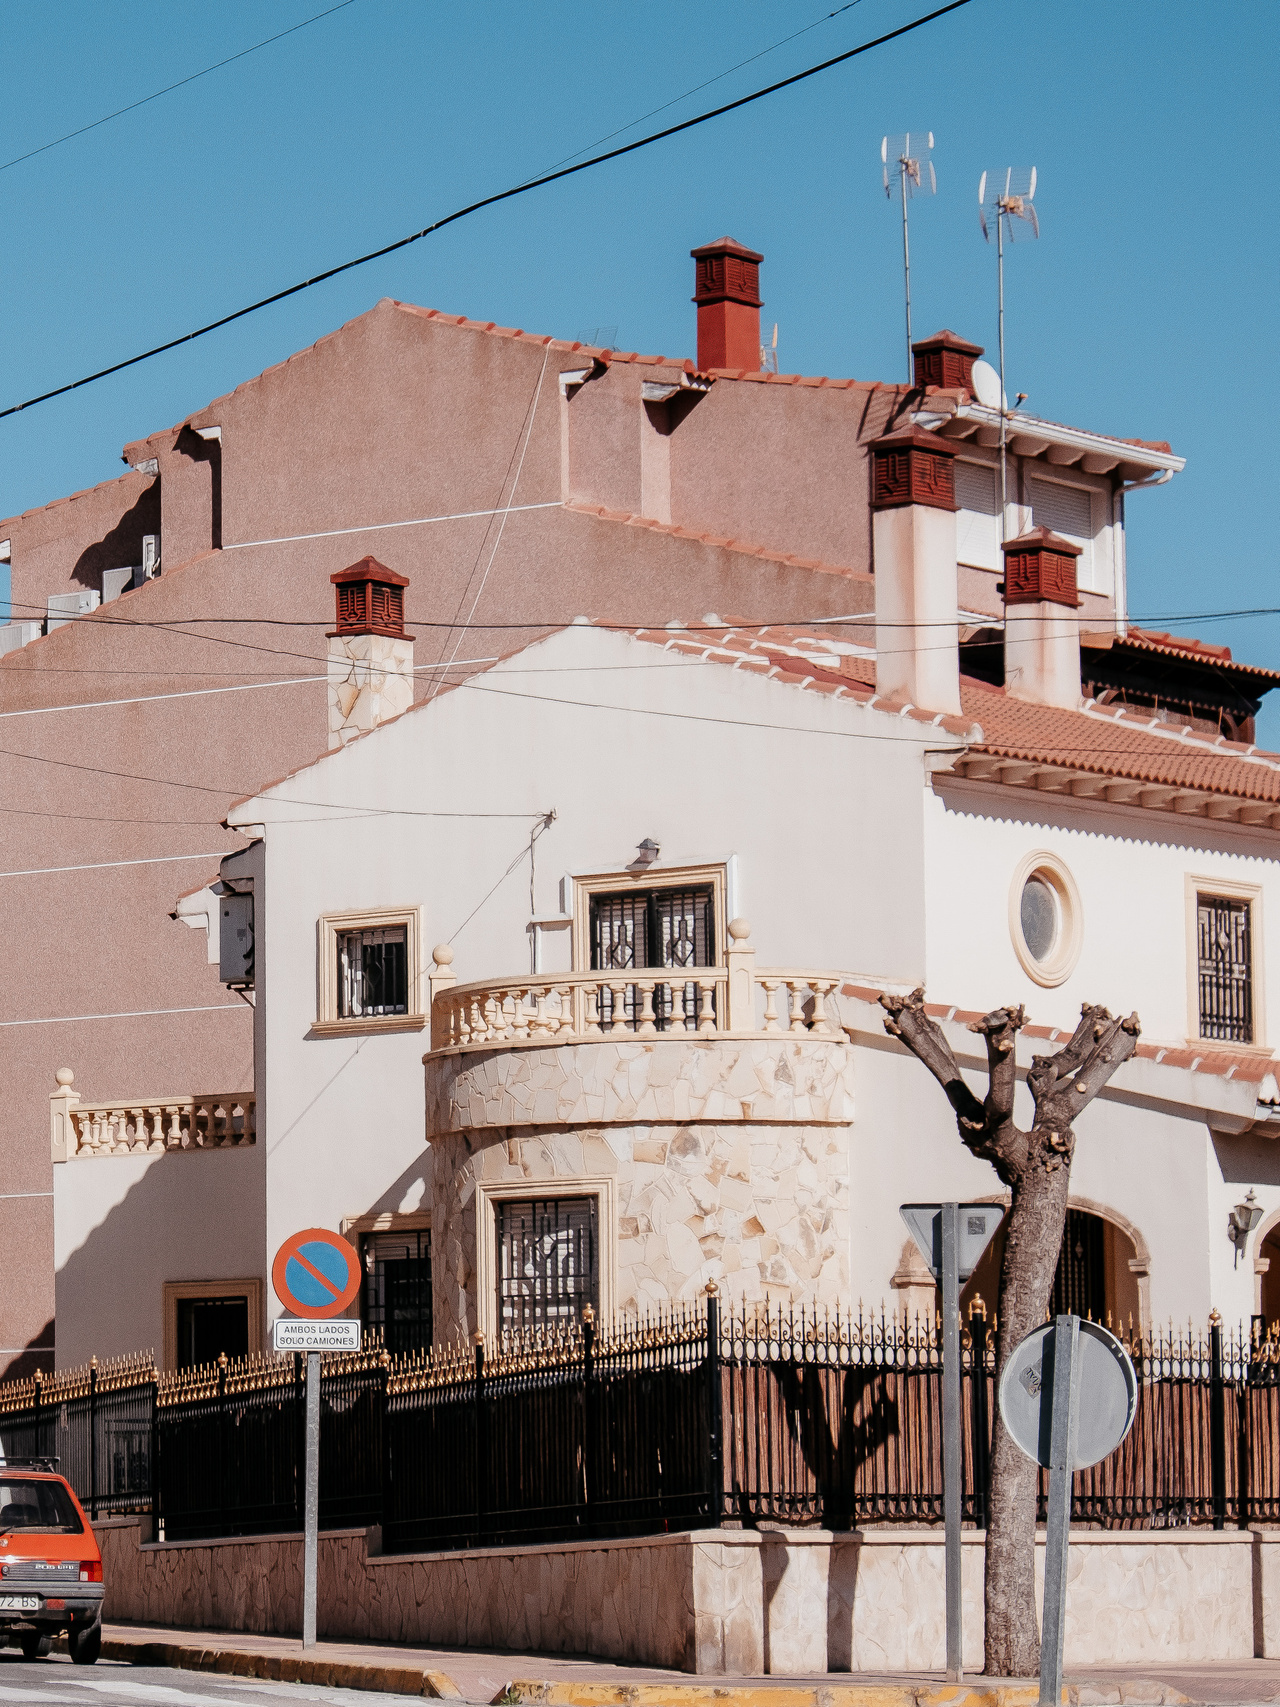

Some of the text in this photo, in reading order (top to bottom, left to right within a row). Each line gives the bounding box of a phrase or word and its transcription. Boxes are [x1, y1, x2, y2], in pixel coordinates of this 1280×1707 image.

[284, 1326, 350, 1334] AMBOS LADOS
[279, 1337, 354, 1345] SOLO CAMIONES
